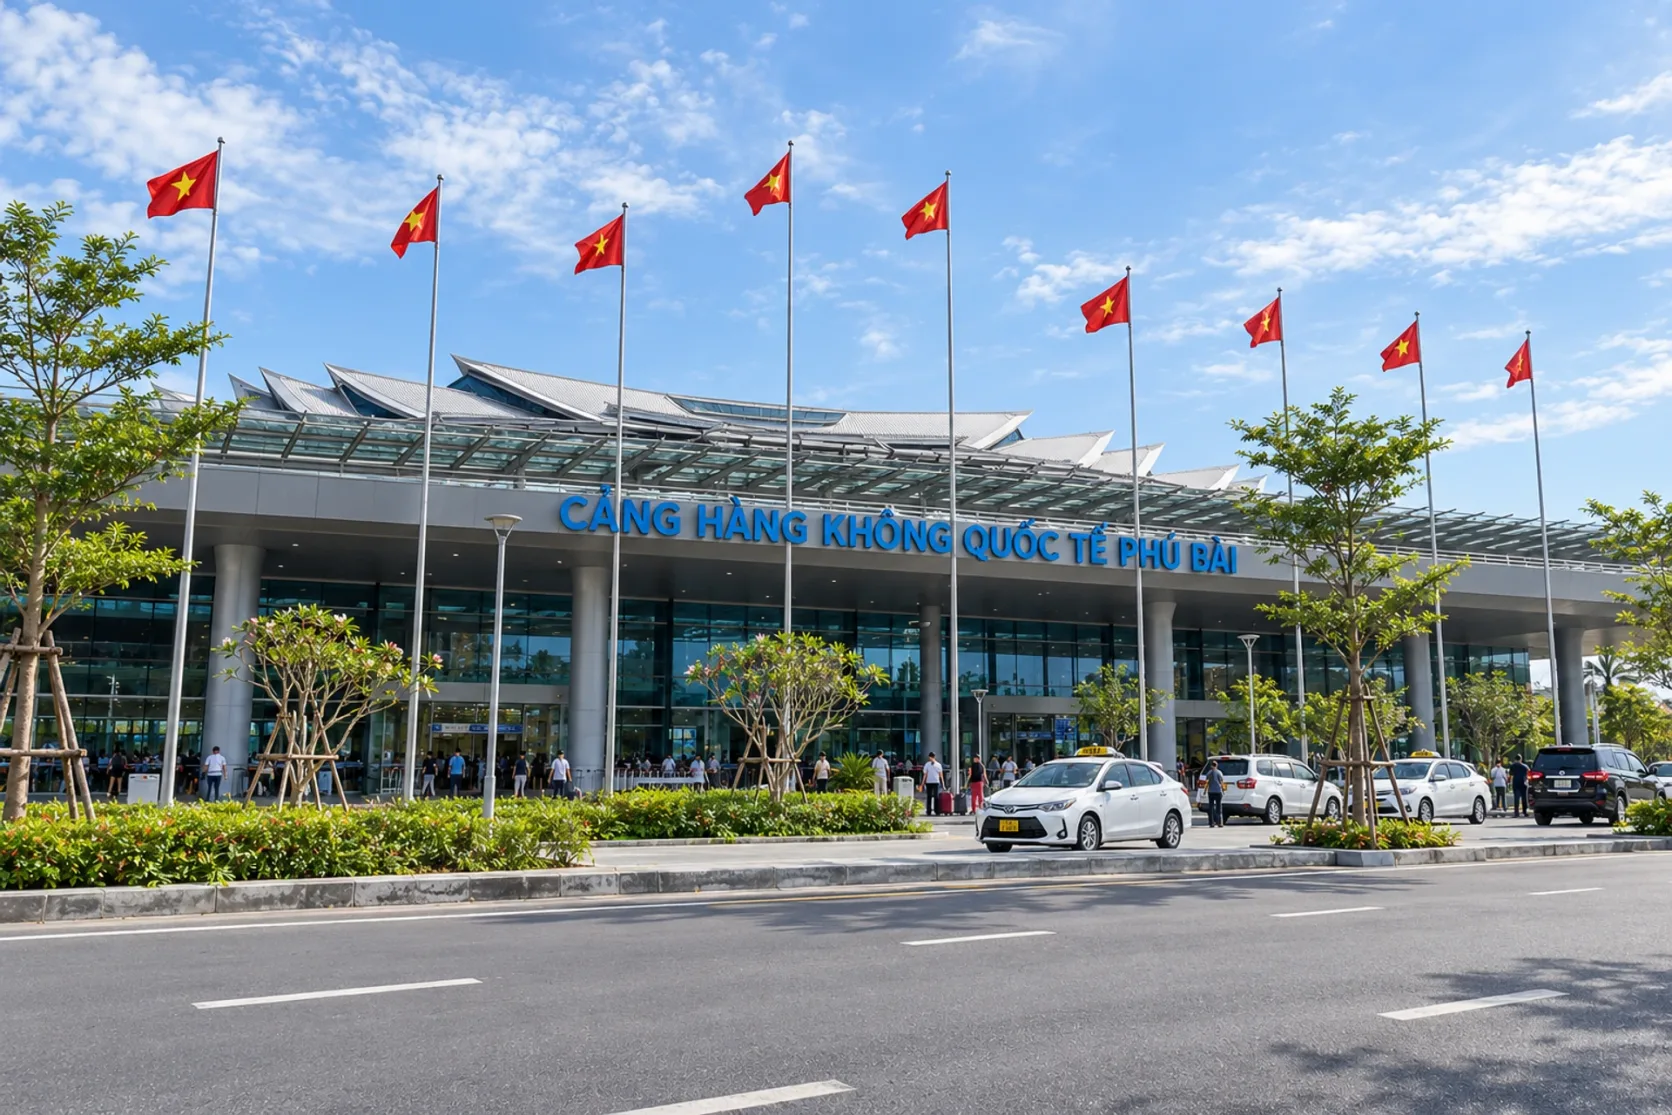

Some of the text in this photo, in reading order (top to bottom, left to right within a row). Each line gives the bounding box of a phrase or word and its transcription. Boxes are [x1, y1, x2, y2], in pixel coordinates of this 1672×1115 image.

[559, 484, 1237, 575] CẢNG HÀNG KHÔNG QUỐC TẾ PHÚ BÀI
